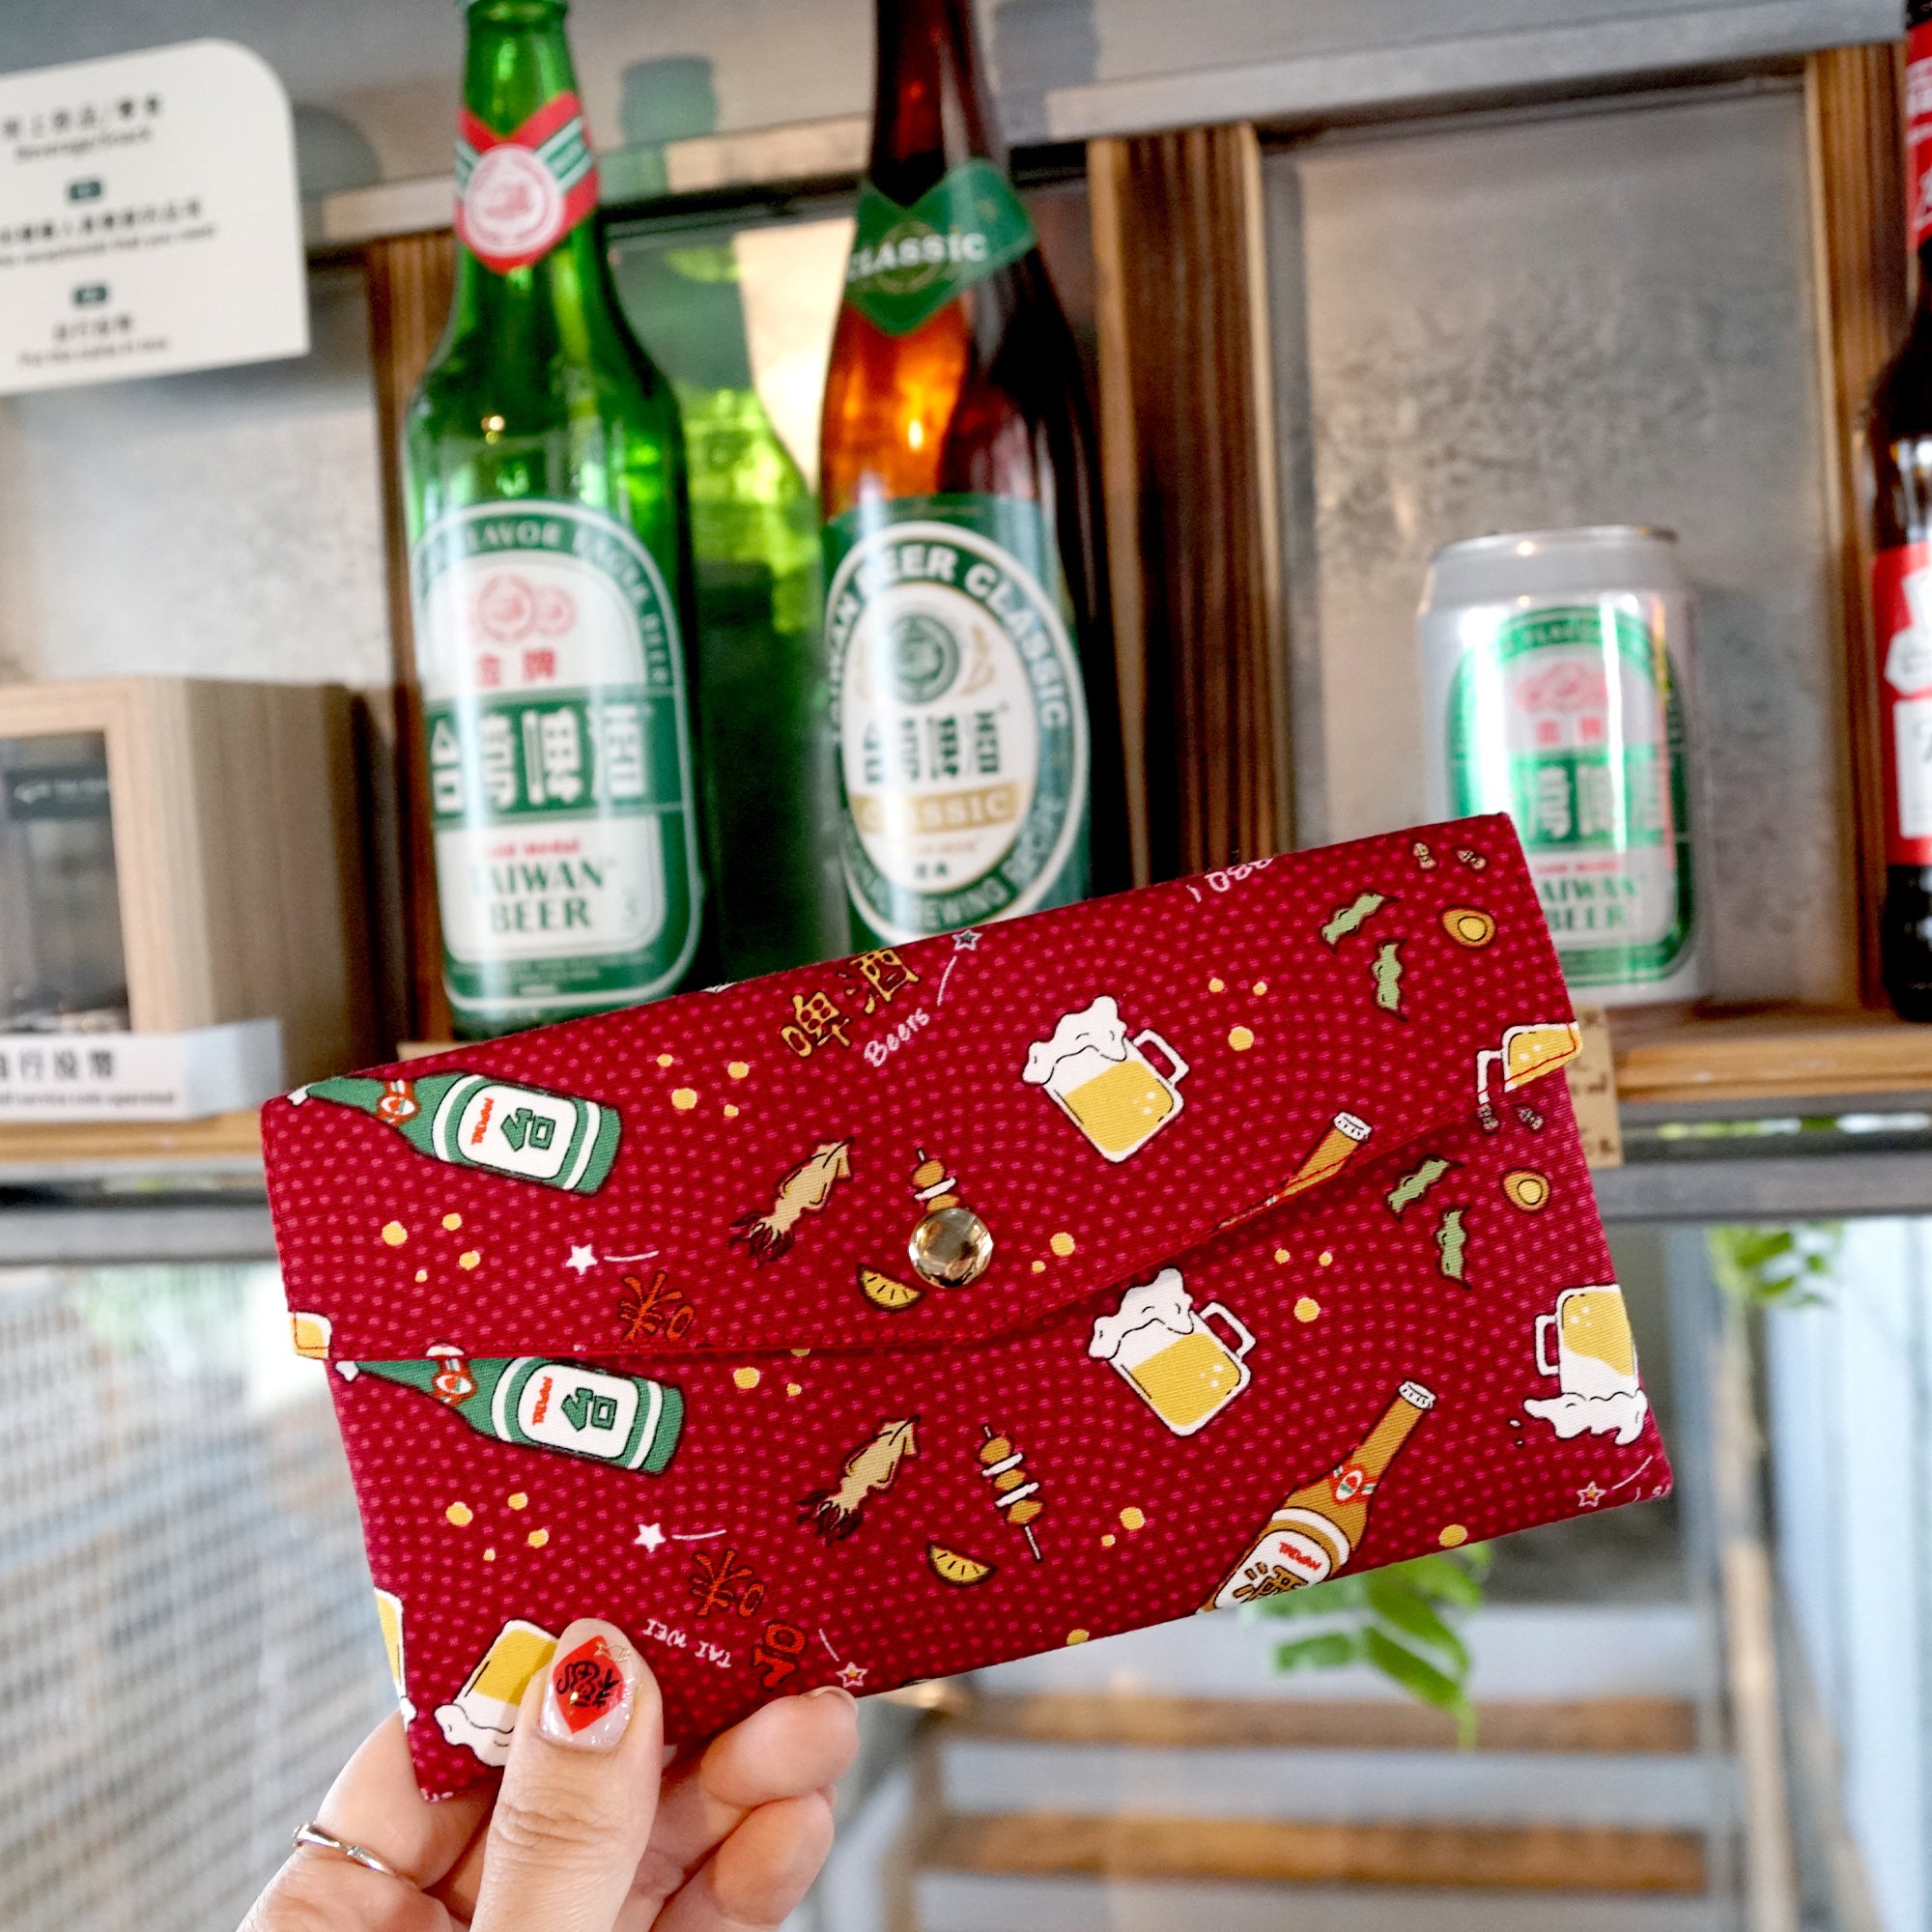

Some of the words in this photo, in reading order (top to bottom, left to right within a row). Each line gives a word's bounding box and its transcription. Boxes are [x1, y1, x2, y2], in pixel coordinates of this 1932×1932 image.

[490, 897, 592, 933] BEER
[864, 1007, 930, 1067] Beers
[500, 1107, 556, 1152] 台
[560, 1387, 618, 1432] 台
[641, 1618, 689, 1648] WEI
[694, 1639, 732, 1668] TAI
